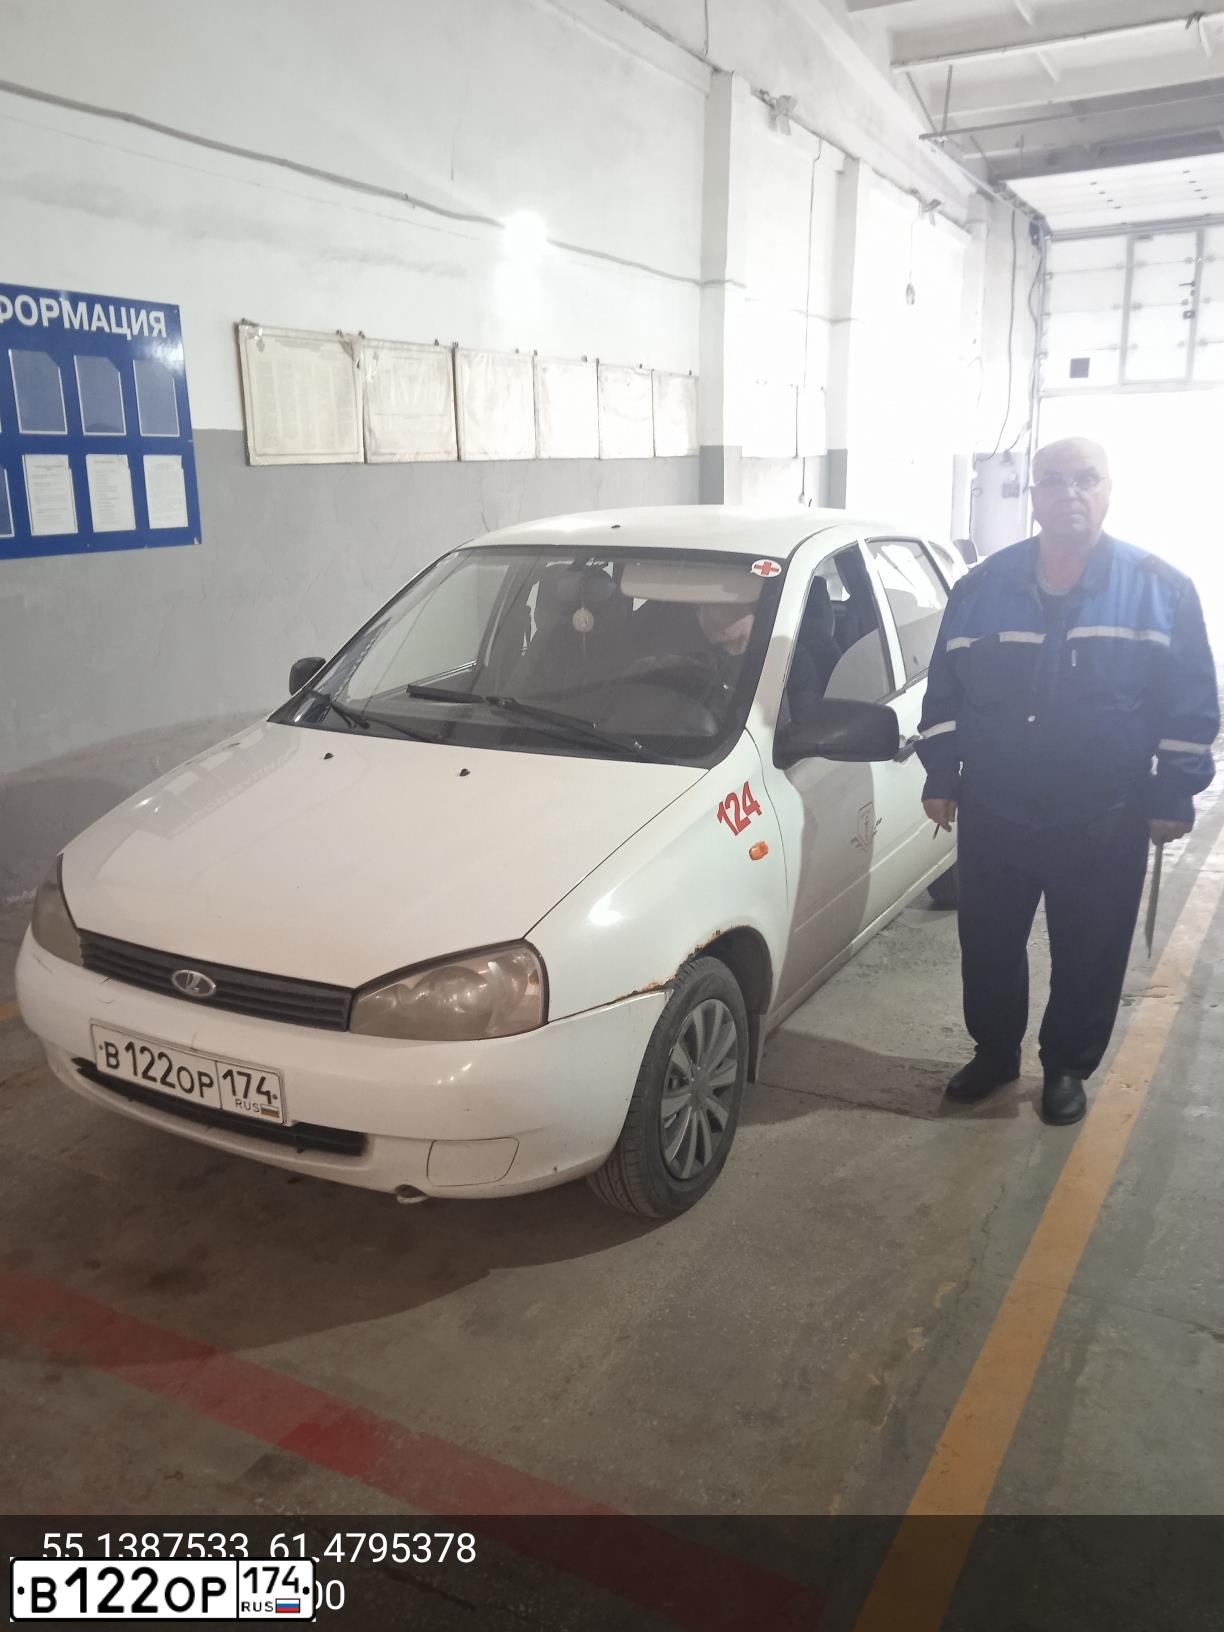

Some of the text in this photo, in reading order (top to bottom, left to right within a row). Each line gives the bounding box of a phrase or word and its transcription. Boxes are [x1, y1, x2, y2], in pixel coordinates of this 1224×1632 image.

[716, 781, 762, 836] 124
[222, 1068, 272, 1104] 174
[234, 1098, 261, 1113] RUS
